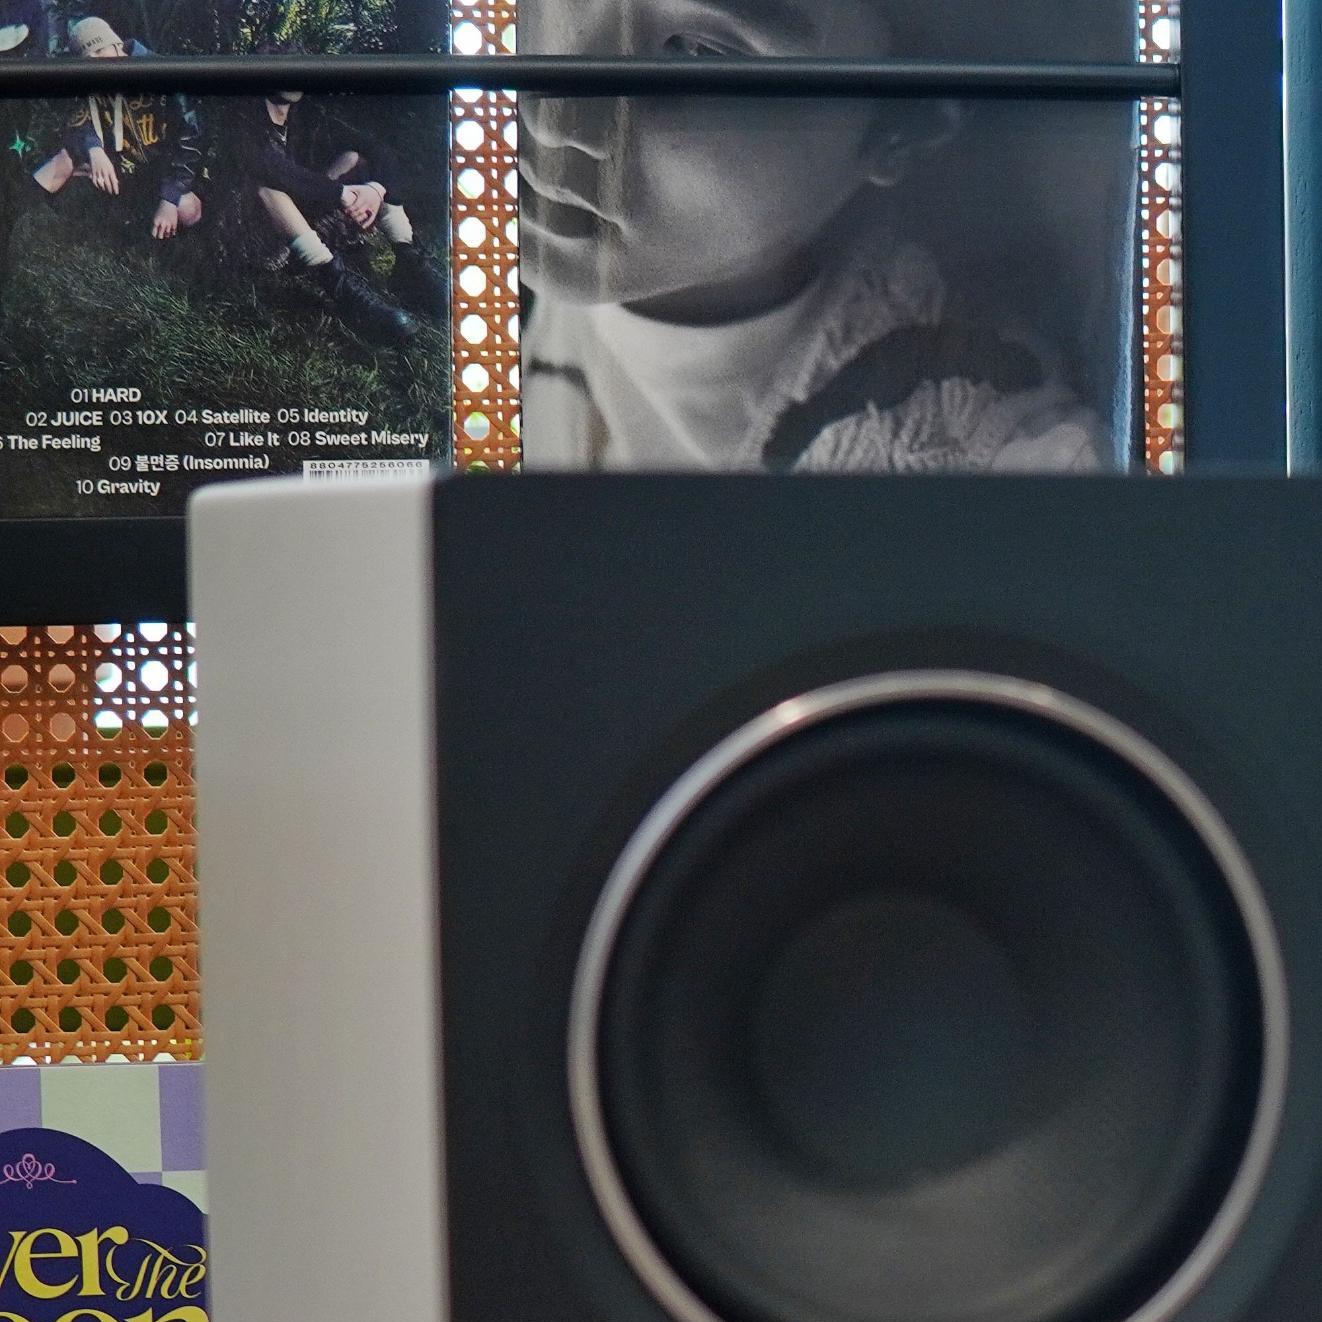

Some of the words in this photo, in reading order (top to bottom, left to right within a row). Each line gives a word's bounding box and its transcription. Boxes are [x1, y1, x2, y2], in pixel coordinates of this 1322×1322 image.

[71, 388, 89, 404] 01
[92, 387, 142, 403] HARD
[26, 411, 48, 427] 02
[51, 410, 104, 427] JUICE
[110, 410, 133, 426] 03
[136, 409, 169, 425] 10X
[175, 409, 199, 425] 04
[202, 408, 271, 425] Satellite
[277, 408, 300, 424] 05
[304, 407, 369, 426] Identity
[7, 434, 39, 451] The
[42, 433, 102, 453] Feeling
[205, 431, 225, 448] 07
[229, 431, 265, 447] Like
[268, 431, 281, 447] It
[288, 430, 311, 446] 08
[315, 430, 369, 446] Sweet
[371, 430, 430, 449] Misery
[109, 455, 132, 472] 09
[134, 454, 181, 473] 불면증
[183, 453, 270, 472] (Insomnia)
[76, 479, 94, 495] 10
[97, 478, 161, 497] Gravity
[105, 1237, 208, 1301] The
